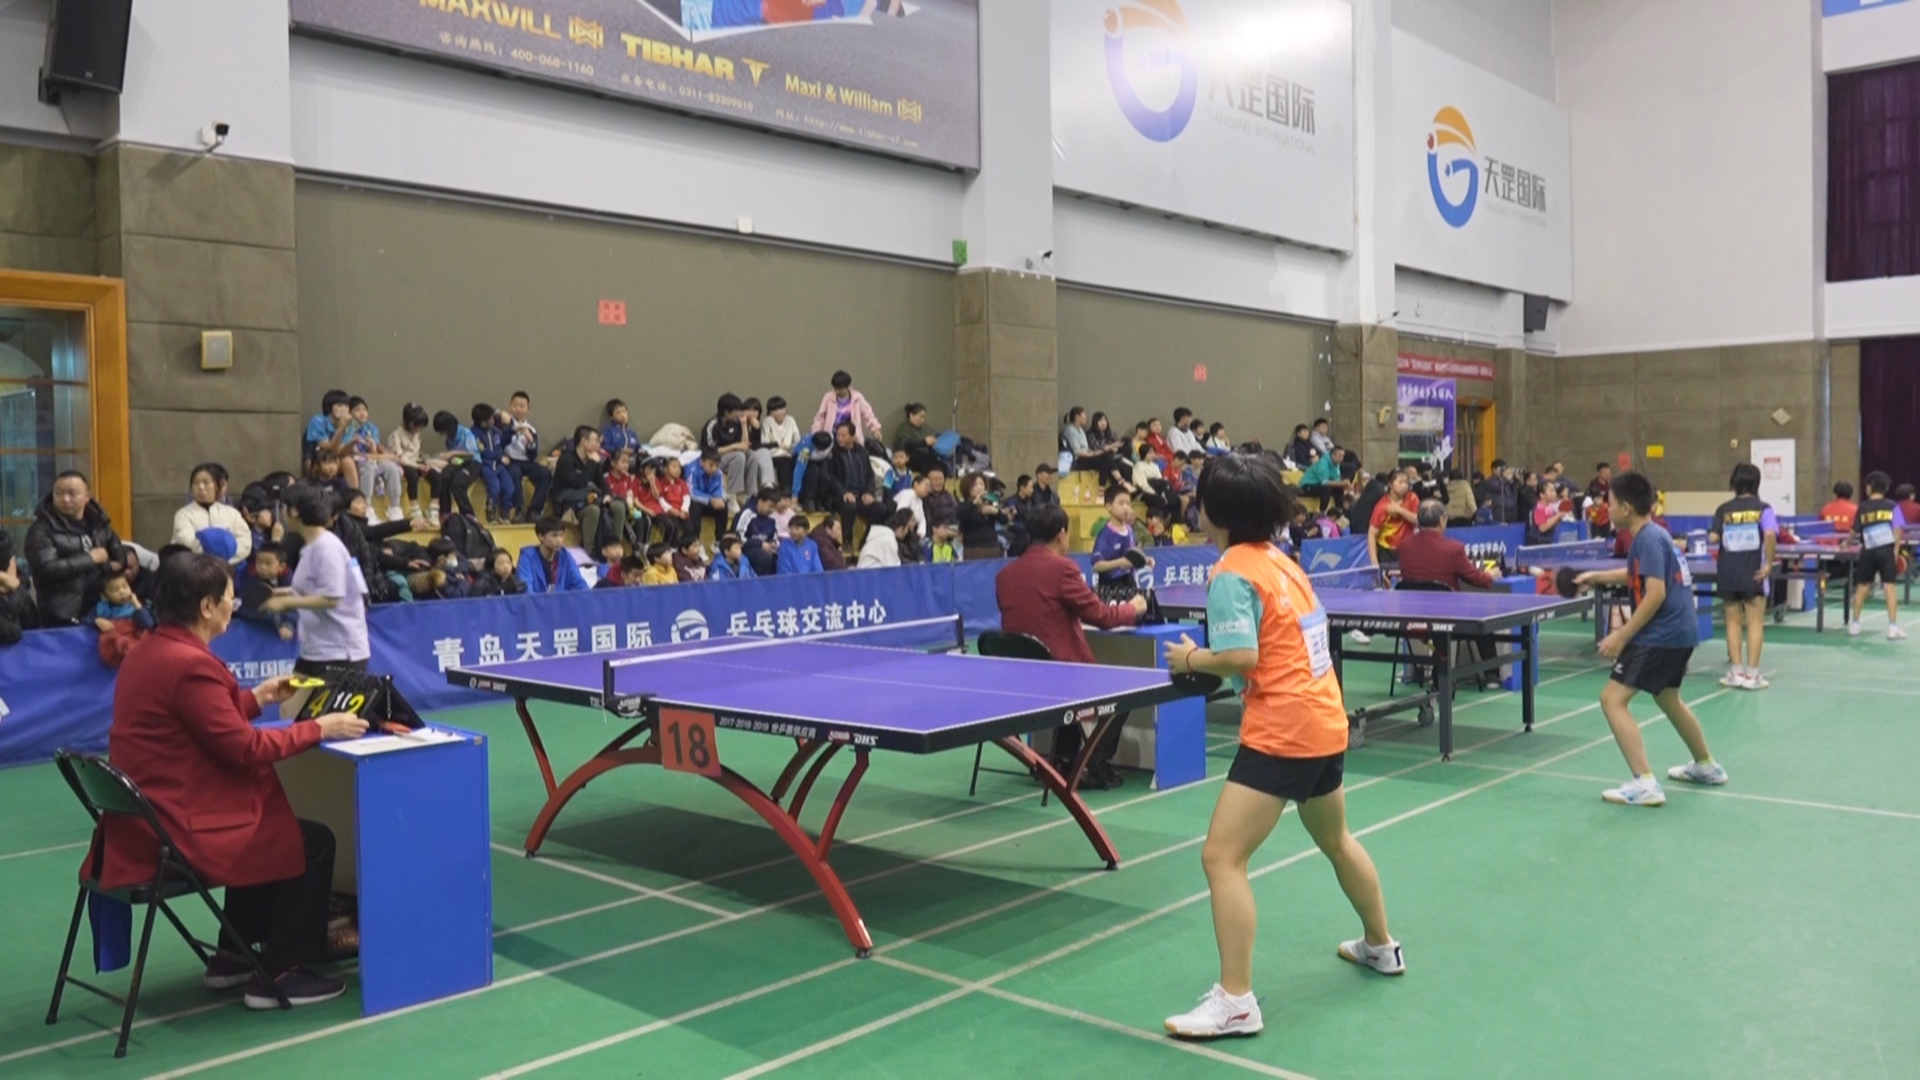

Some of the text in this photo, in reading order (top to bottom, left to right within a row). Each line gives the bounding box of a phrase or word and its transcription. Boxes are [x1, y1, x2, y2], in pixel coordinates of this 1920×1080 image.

[620, 32, 735, 82] TIBHAR
[785, 73, 893, 117] Maxi & William
[1484, 155, 1547, 214] 天罡国际
[433, 598, 888, 673] 青岛天罡国际 乒乓球交流中心
[667, 720, 711, 769] 18
[852, 732, 880, 747] DHS
